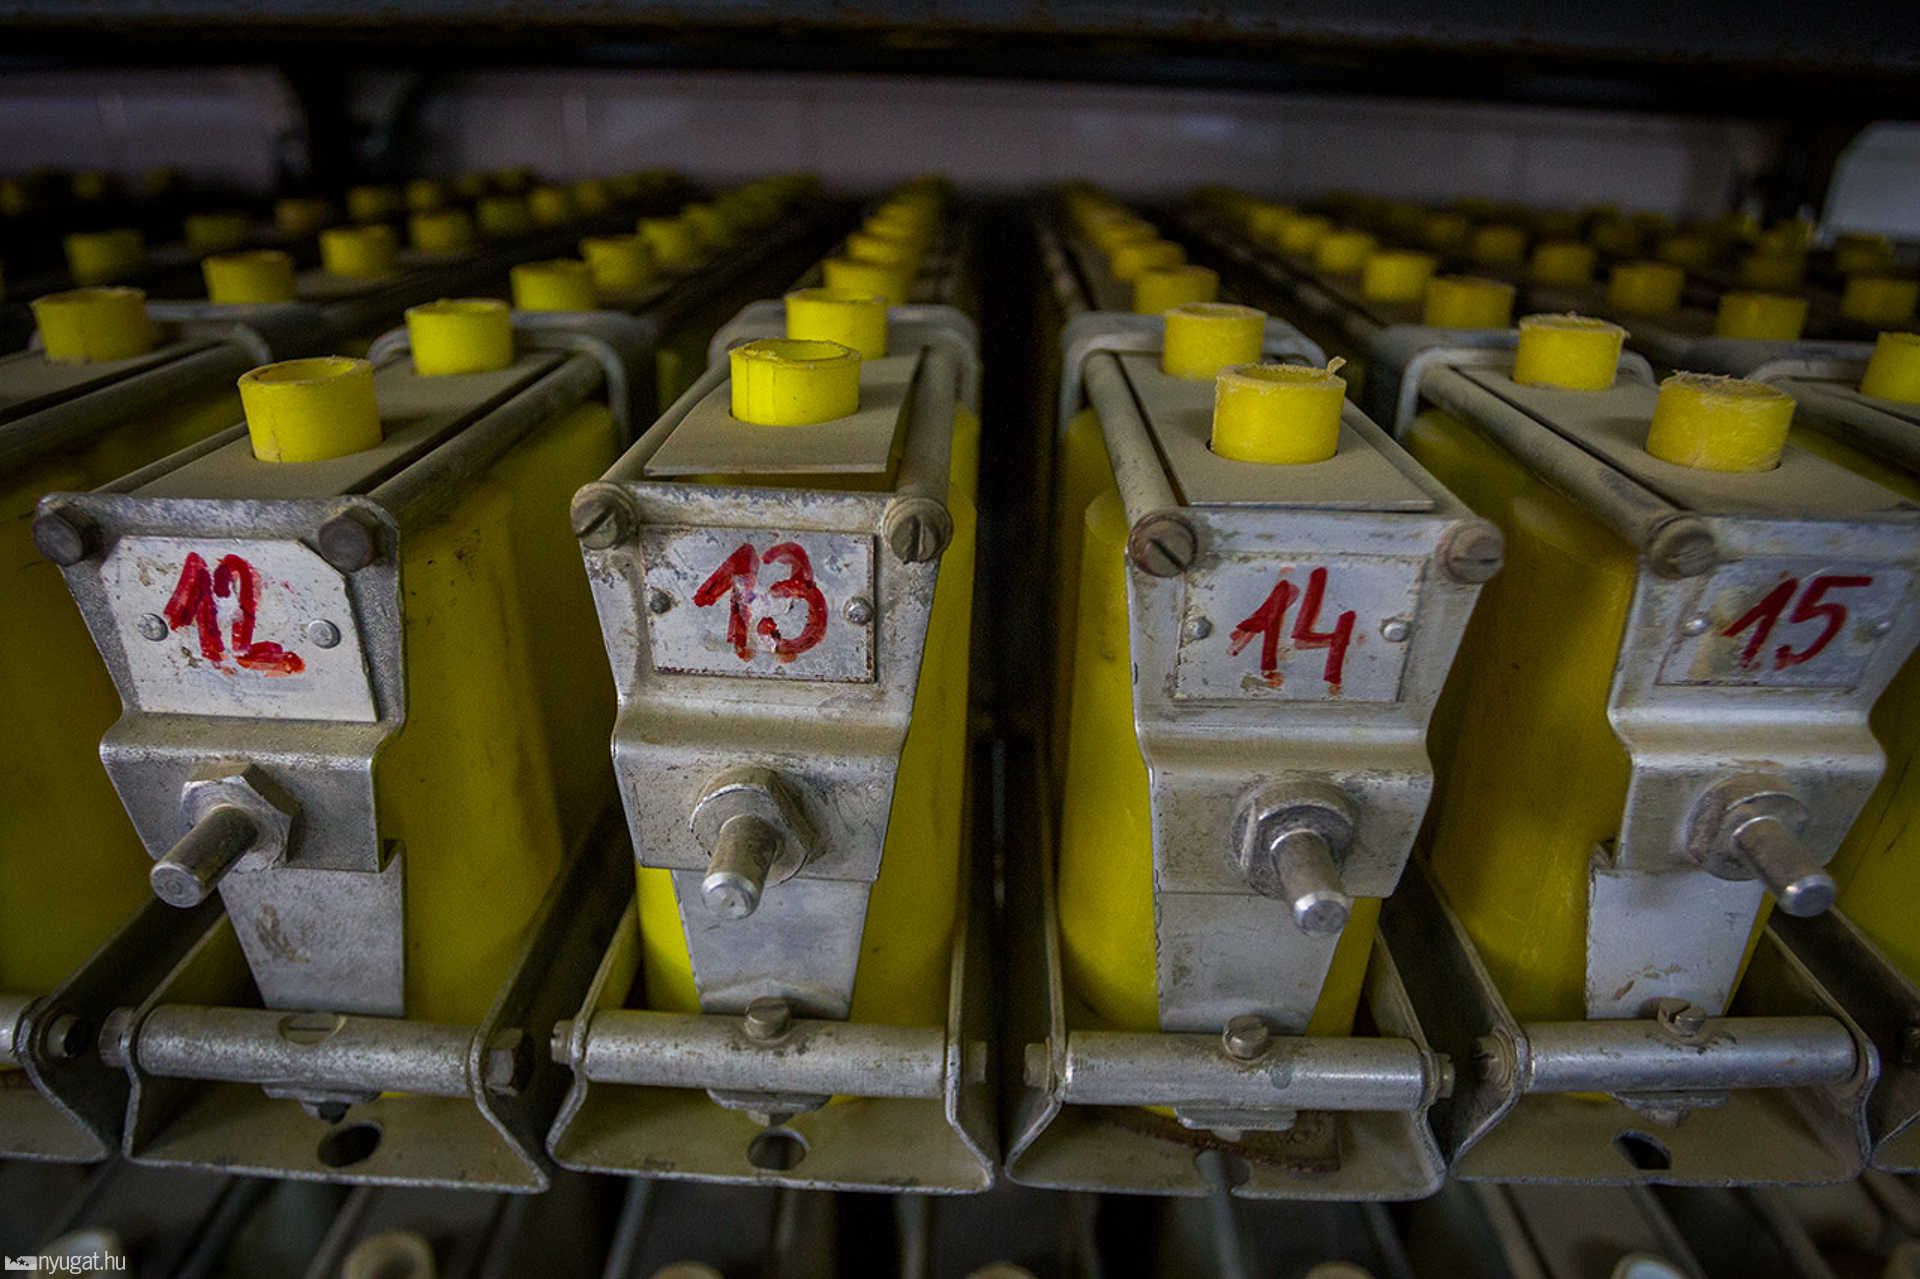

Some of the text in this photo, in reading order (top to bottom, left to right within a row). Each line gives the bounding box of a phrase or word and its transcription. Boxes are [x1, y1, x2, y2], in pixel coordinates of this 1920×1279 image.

[163, 551, 305, 677] 12
[692, 542, 829, 662] 13
[1227, 566, 1357, 695] 14
[1723, 573, 1873, 671] 15
